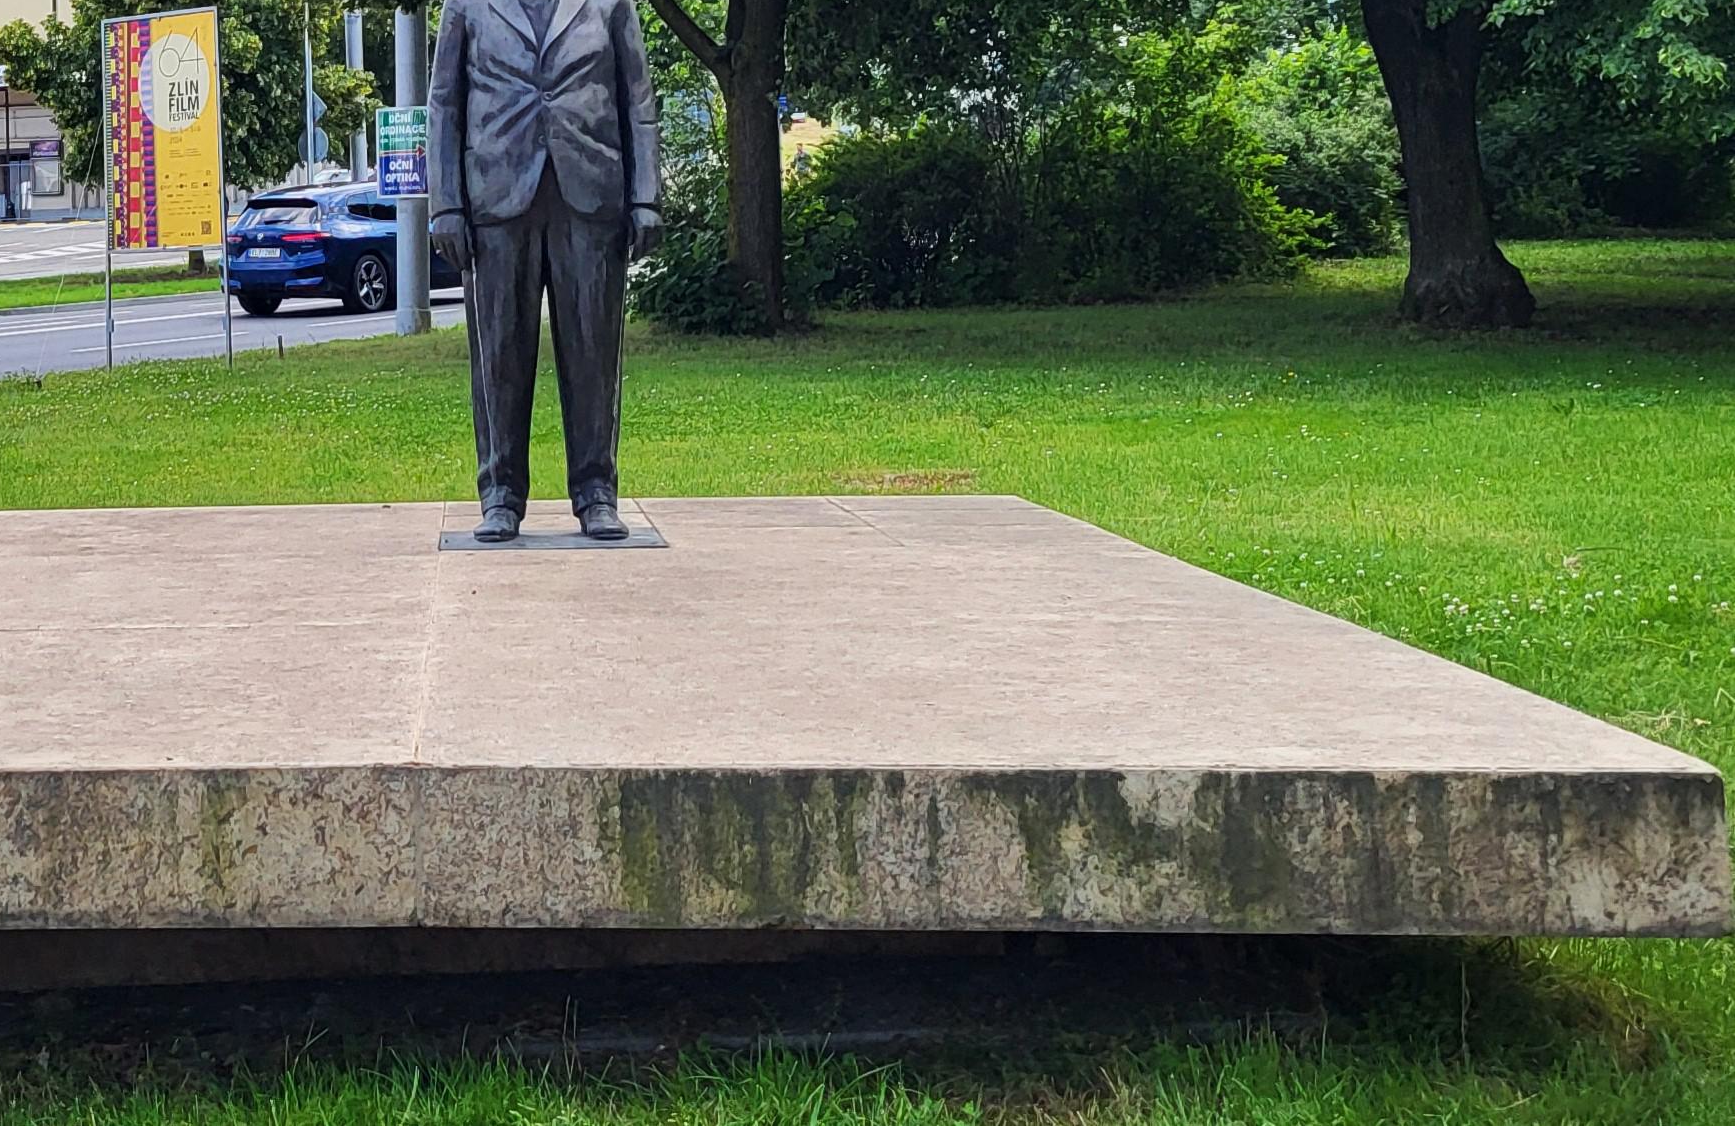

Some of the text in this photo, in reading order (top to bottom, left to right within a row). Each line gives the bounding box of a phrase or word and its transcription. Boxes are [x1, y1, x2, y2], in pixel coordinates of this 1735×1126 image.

[158, 26, 204, 78] 64
[168, 77, 199, 97] ZLÍN
[168, 96, 200, 113] FILM
[168, 111, 200, 122] FESTIVAL
[380, 124, 426, 136] ORDINACE
[388, 158, 414, 171] OČNÍ
[385, 171, 420, 183] OPTIKA
